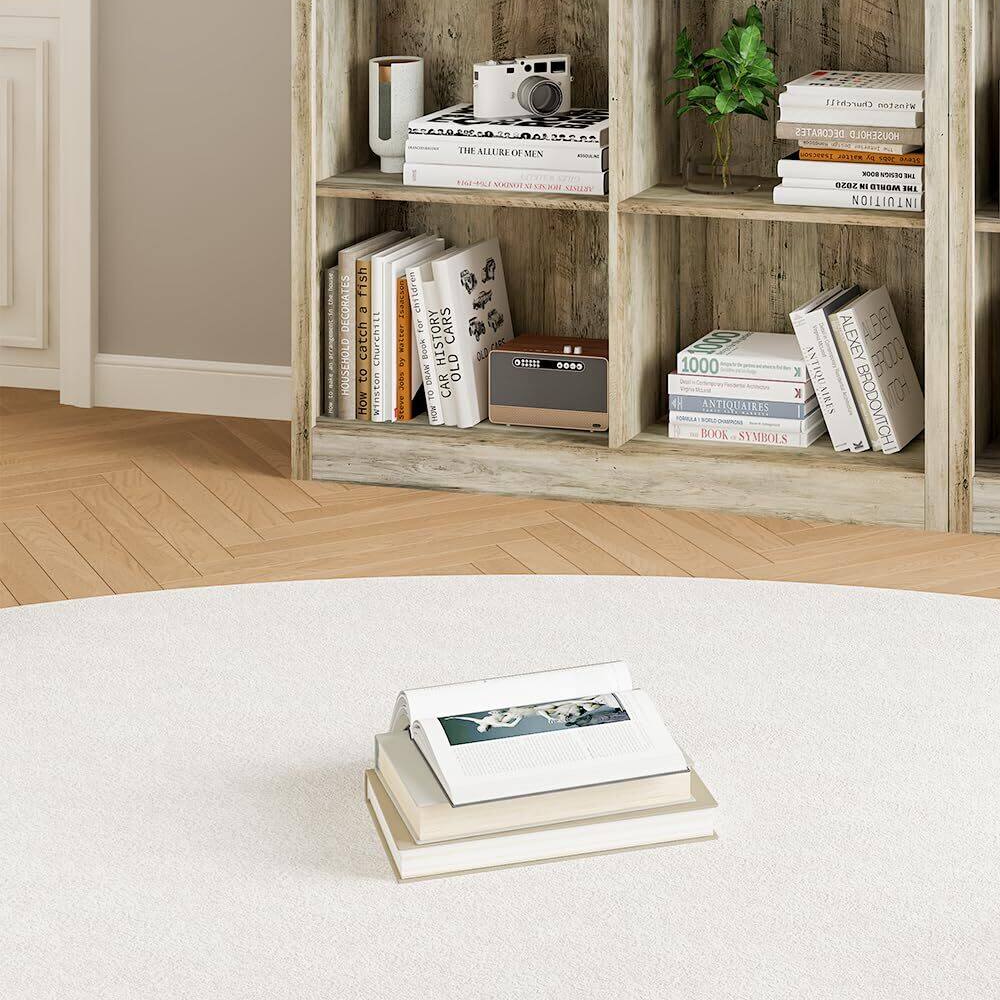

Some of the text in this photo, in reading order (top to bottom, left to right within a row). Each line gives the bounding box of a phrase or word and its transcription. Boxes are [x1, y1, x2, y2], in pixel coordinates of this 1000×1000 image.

[458, 146, 544, 159] THE ALLURE OF MEN
[899, 156, 921, 164] Steve
[880, 171, 903, 179] DESIGN
[493, 181, 524, 189] LONDON
[835, 182, 858, 190] 2020
[860, 182, 869, 190] IN
[870, 183, 901, 192] WORLD
[852, 195, 918, 208] INTUITION
[341, 275, 350, 396] HOUSEHOLD DECORATES
[357, 267, 367, 415] How to catch a fish
[687, 330, 743, 355] 1000
[409, 271, 438, 422] HOW TO DRAW Book for children
[440, 307, 461, 382] OLD CARS
[428, 309, 452, 398] CAR HISTORY
[476, 347, 489, 362] OLD
[399, 358, 405, 367] by
[681, 357, 719, 374] 1000
[805, 346, 834, 414] ANTIQUAIRES
[840, 315, 868, 362] ALEXEY
[856, 364, 895, 447] BRODOVITCH
[327, 391, 334, 399] to
[702, 399, 770, 413] ANTIQUAIRES
[701, 428, 788, 444] BOOK SYMBOLS
